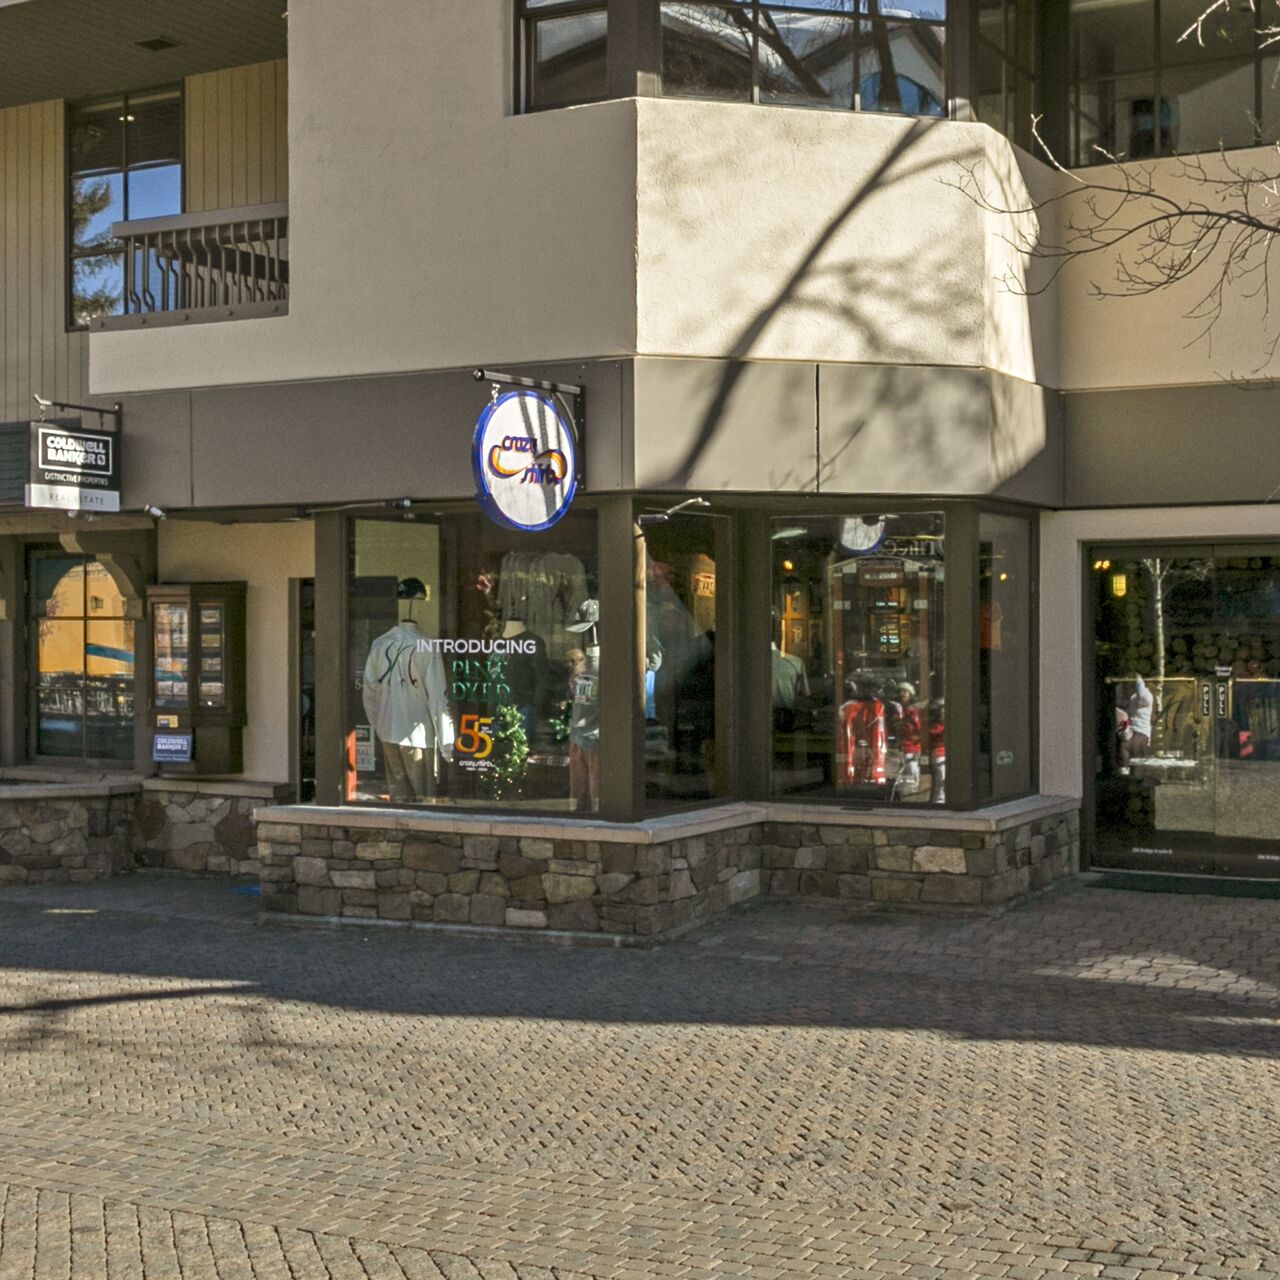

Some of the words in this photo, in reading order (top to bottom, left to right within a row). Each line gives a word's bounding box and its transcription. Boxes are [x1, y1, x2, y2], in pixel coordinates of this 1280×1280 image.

[47, 436, 106, 453] COLDWELL
[47, 448, 96, 465] BANKER
[44, 471, 77, 483] DISTINCTIVE
[48, 493, 72, 502] REAL
[416, 639, 537, 655] INTRODUCING
[455, 714, 493, 759] 55
